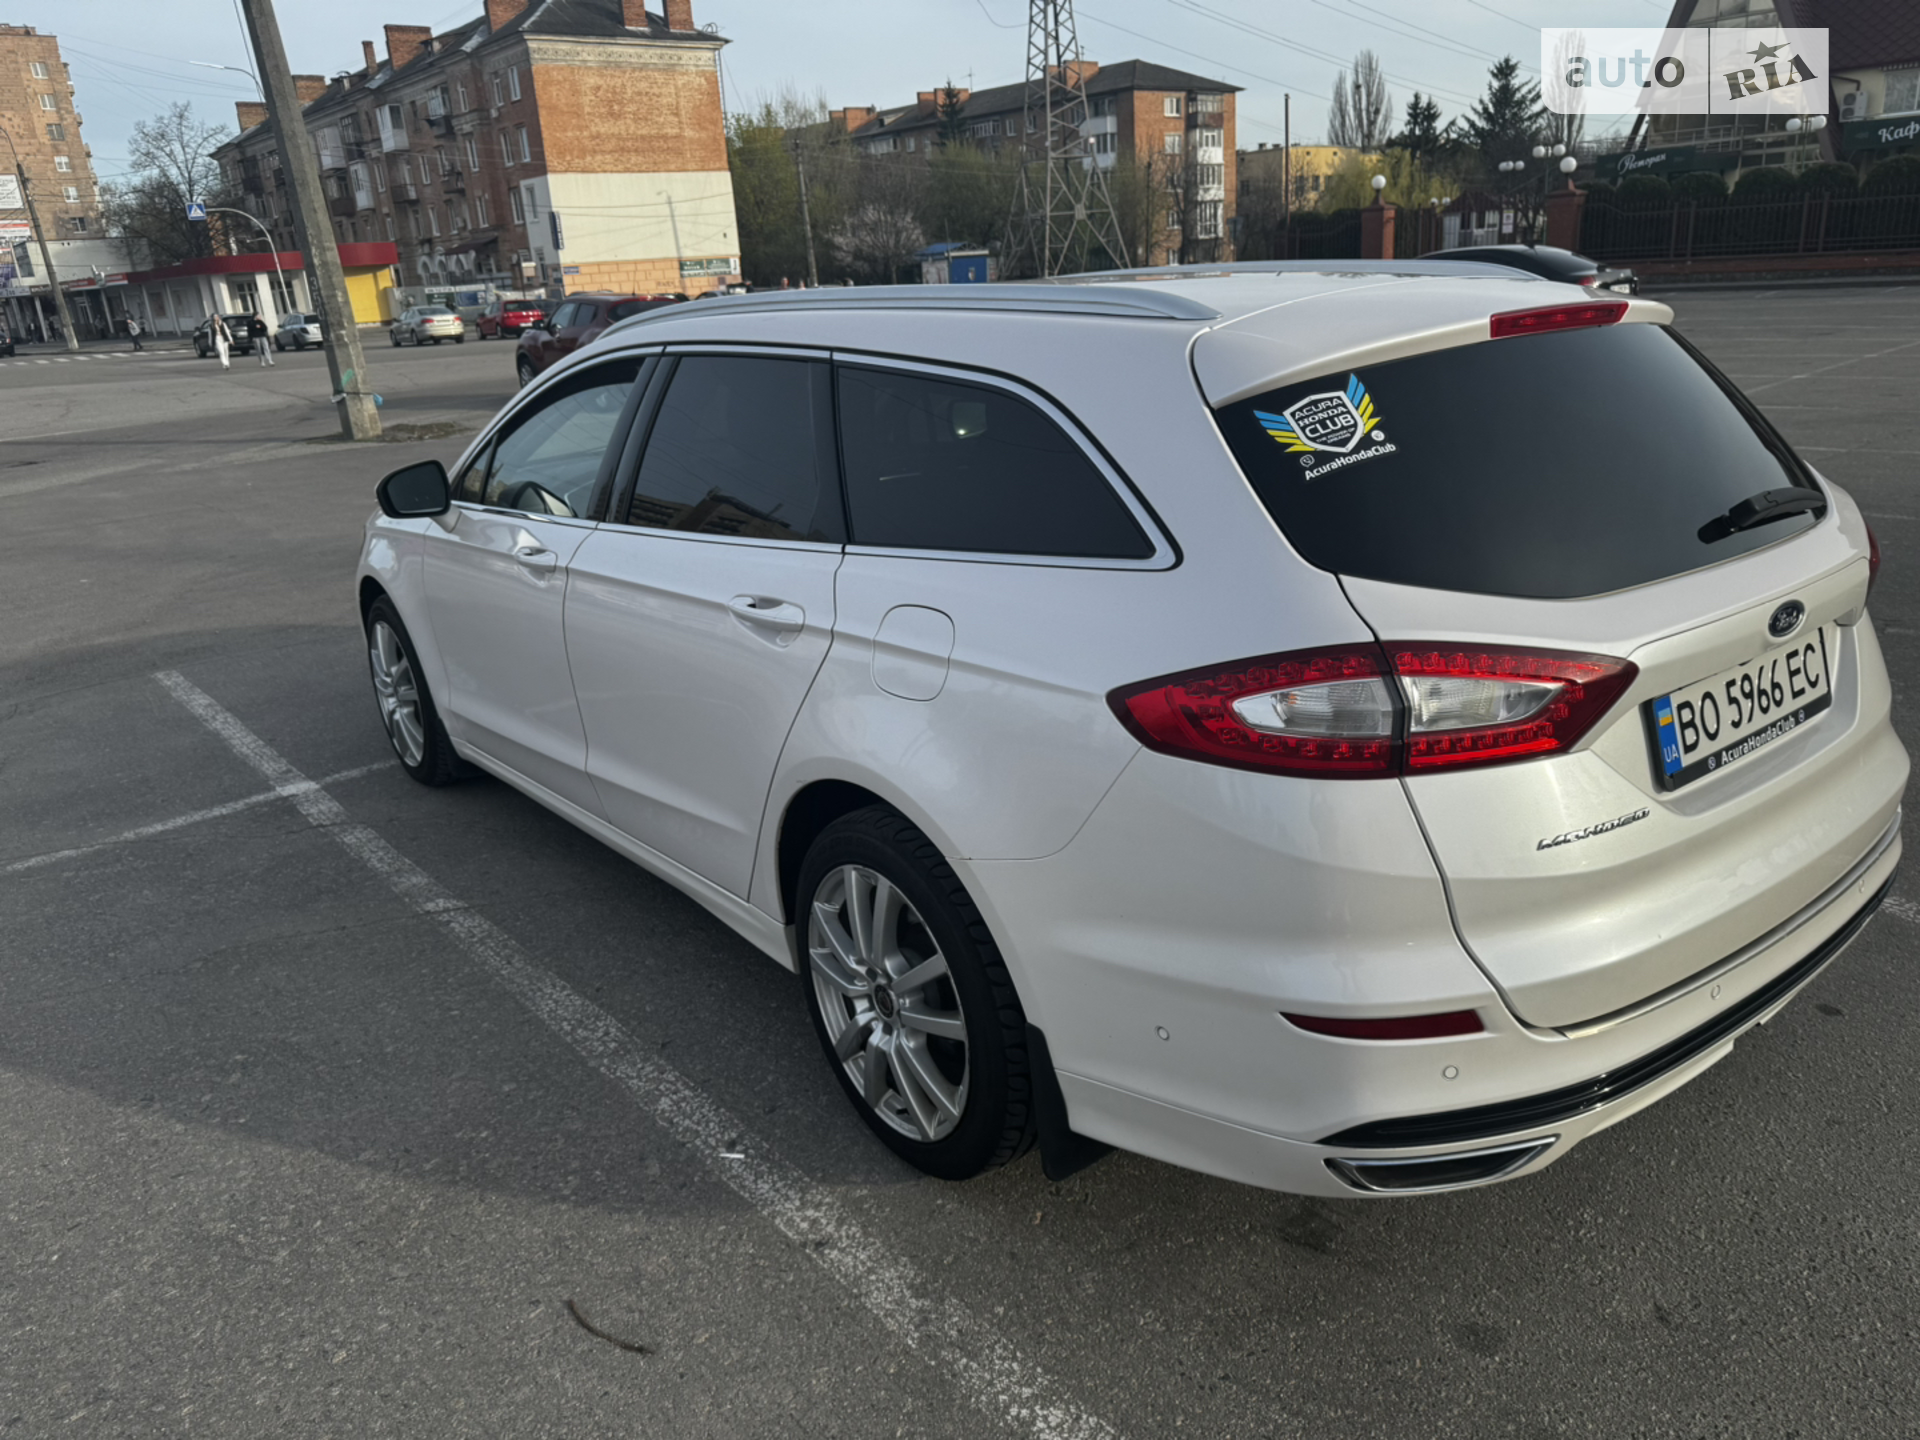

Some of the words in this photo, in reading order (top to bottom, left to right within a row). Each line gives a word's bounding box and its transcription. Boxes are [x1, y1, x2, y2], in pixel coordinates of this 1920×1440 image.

[1878, 120, 1920, 144] Каф
[1617, 152, 1667, 176] Ресторан
[1294, 397, 1343, 420] ACURA
[1298, 406, 1349, 427] HONDA
[1305, 414, 1355, 438] CLUB
[1304, 443, 1397, 481] AcuraHondaClub
[1676, 690, 1721, 755] BO
[1725, 659, 1784, 729] 5966
[1785, 642, 1820, 700] EC
[1721, 715, 1796, 765] AcuraHondaClub
[1663, 744, 1680, 763] UA
